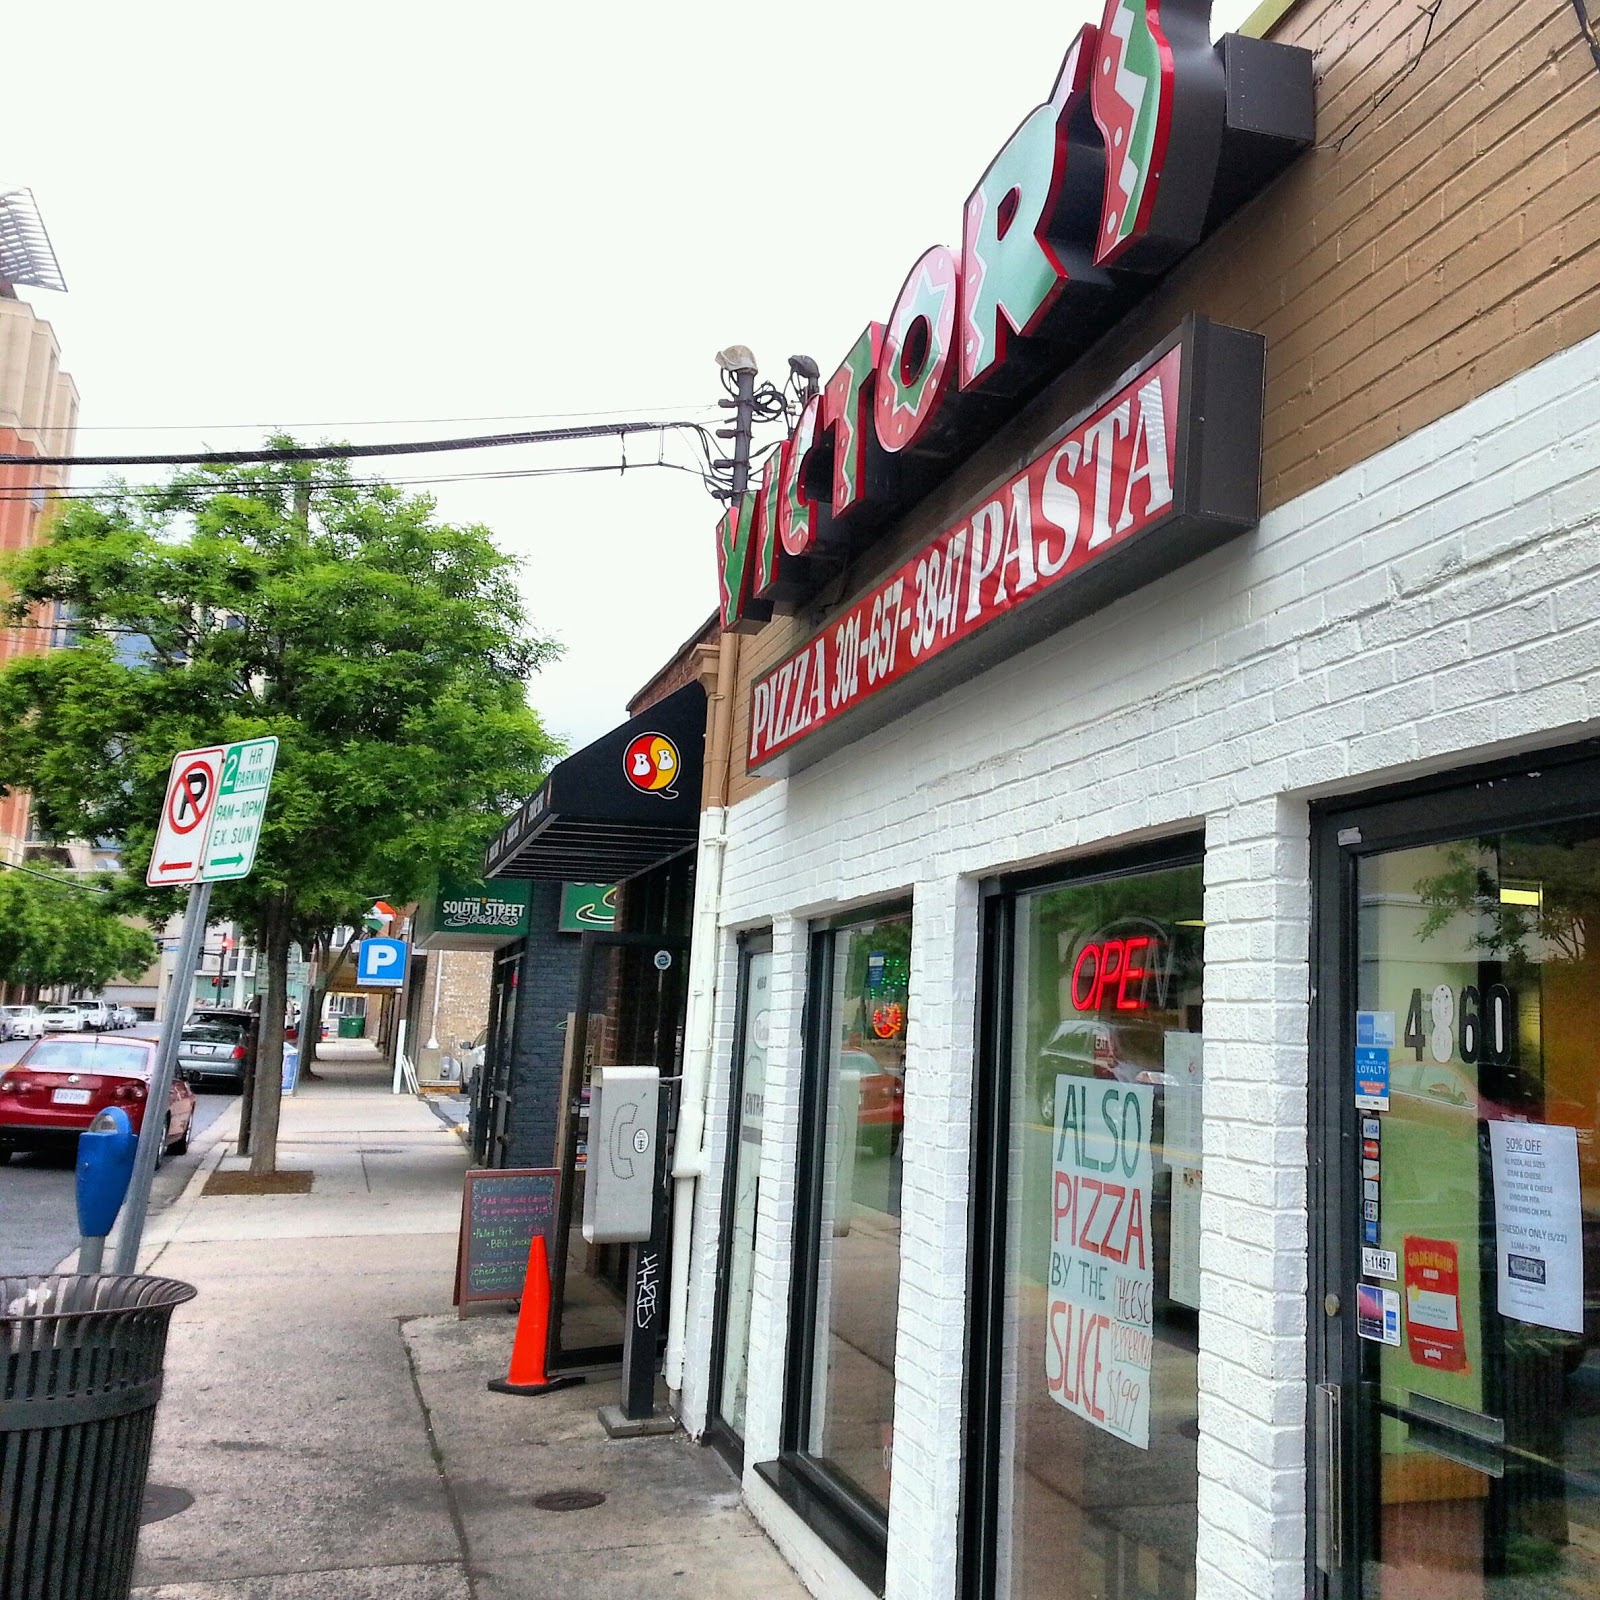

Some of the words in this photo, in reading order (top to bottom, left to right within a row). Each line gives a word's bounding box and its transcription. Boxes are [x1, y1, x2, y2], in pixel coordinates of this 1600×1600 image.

[749, 637, 826, 760] PIZZA
[831, 527, 968, 711] 301-657-3847
[964, 375, 1174, 624] PASTA
[222, 754, 239, 787] 2
[249, 748, 263, 766] HR
[235, 767, 269, 788] PARKING
[231, 826, 252, 845] SUN
[443, 901, 480, 914] SOUTH
[485, 903, 525, 917] STREET
[366, 944, 398, 975] P
[1404, 984, 1511, 1065] 4860
[1356, 1065, 1386, 1075] LOYALTY
[1057, 1084, 1142, 1178] ALSO
[1365, 1125, 1378, 1133] VISA
[1506, 1137, 1523, 1150] 50%
[1524, 1139, 1542, 1152] OFF
[1054, 1171, 1145, 1270] PIZZA
[1528, 1228, 1547, 1240] ONLY
[1547, 1233, 1568, 1244] (5/22)
[1050, 1252, 1072, 1288] BY
[1078, 1260, 1108, 1300] THE
[1113, 1275, 1151, 1325] CHEESE
[1048, 1301, 1110, 1422] SLICE
